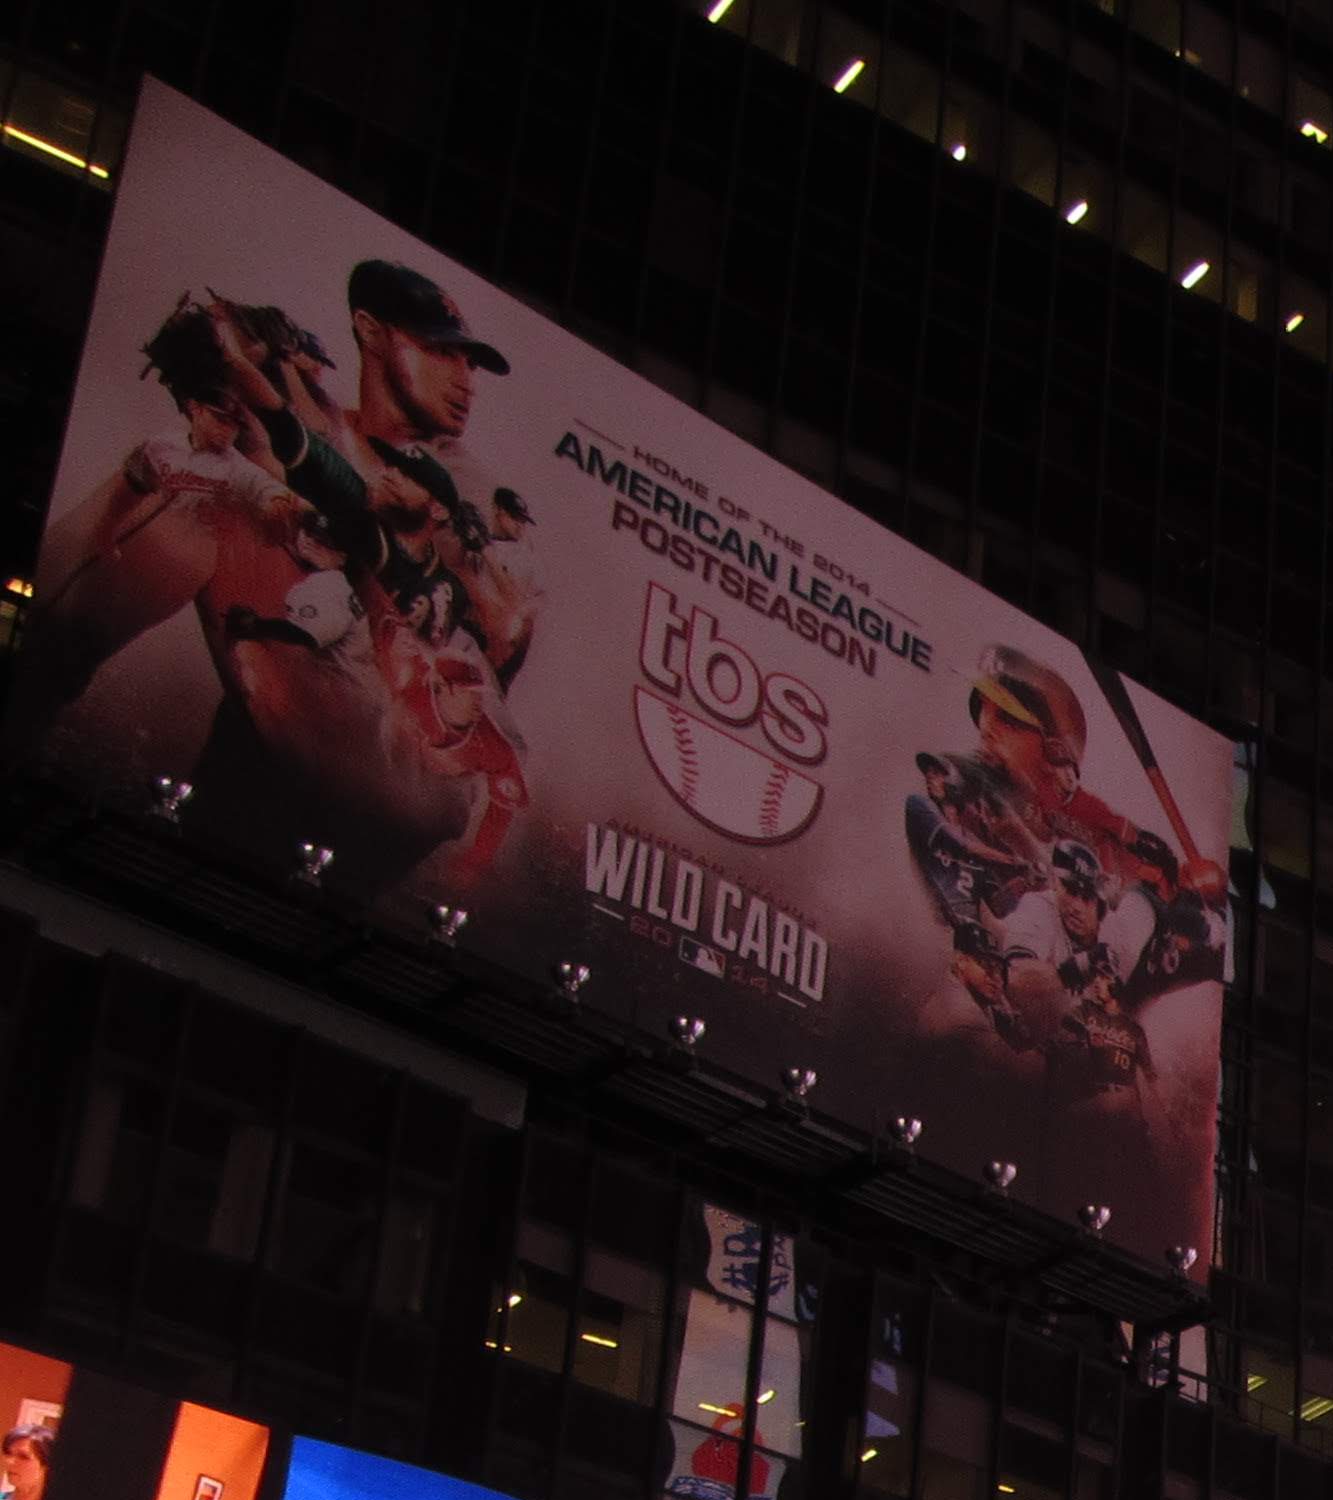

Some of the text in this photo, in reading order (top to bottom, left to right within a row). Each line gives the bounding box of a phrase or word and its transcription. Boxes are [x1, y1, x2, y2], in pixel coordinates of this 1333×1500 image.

[554, 431, 934, 673] AMERICAN LEAGUE
[611, 498, 879, 679] POSTSEASON
[631, 446, 871, 598] HOME OF THE 2014
[639, 579, 829, 767] tbs
[585, 821, 829, 1003] WILD CARD
